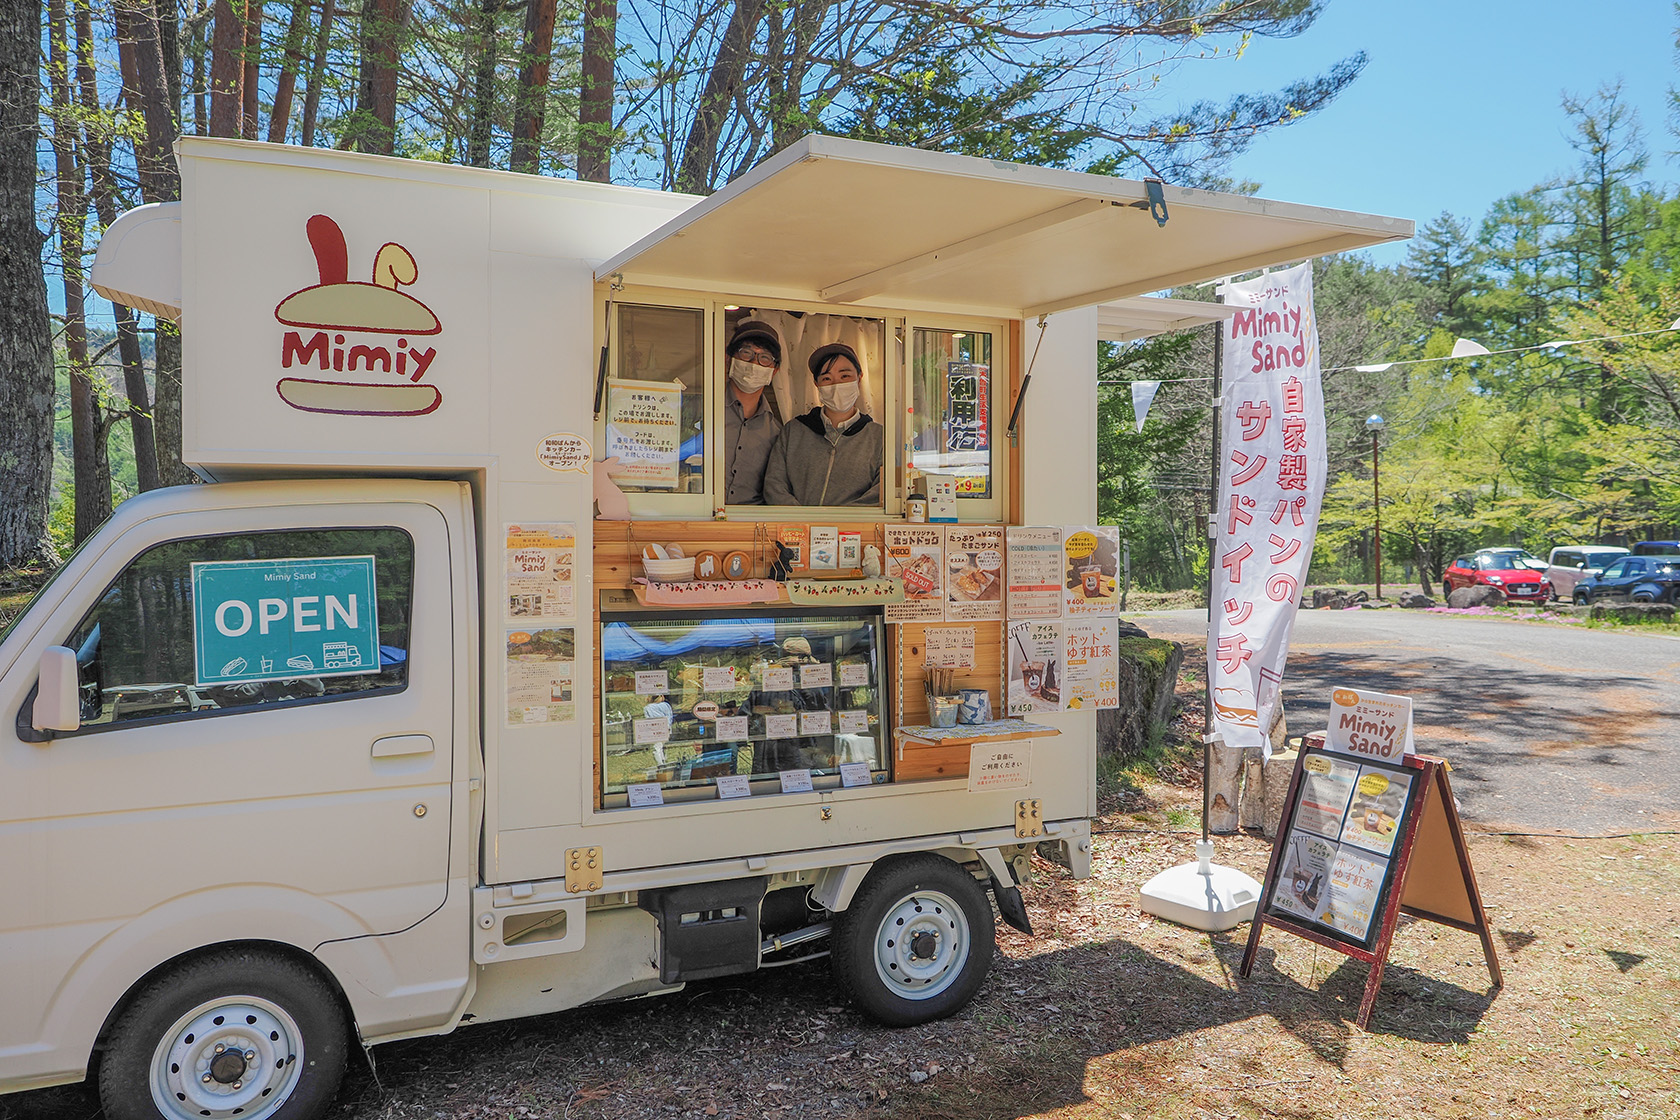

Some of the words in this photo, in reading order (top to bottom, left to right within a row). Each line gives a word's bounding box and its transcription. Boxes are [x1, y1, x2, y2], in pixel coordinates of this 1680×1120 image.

[1248, 286, 1289, 304] ミミーサンド
[1231, 301, 1302, 340] Mimiy
[282, 331, 437, 383] Mimiy
[1251, 330, 1306, 374] Sand
[631, 394, 657, 402] お客様へ
[634, 431, 656, 439] フードは、
[1265, 376, 1308, 604] 自家製パンの
[893, 536, 940, 546] ホットドッグ
[1216, 400, 1272, 675] サンドイッチ
[514, 554, 546, 565] Mimiy
[521, 562, 546, 573] Sand
[264, 573, 292, 583] Mimiy
[293, 572, 317, 580] Sand
[904, 571, 920, 583] SOLD
[918, 579, 930, 589] OUT
[214, 593, 359, 638] OPEN
[1067, 633, 1100, 646] ホット
[1066, 645, 1112, 660] ゆず紅茶
[1010, 703, 1033, 713] ¥450
[1093, 697, 1118, 707] ¥400
[1356, 705, 1395, 718] ミミーサンド
[1339, 713, 1397, 741] Mimiy
[1348, 733, 1394, 758] Sand
[991, 753, 1014, 761] ご自由に
[981, 761, 1023, 771] ご利用ください
[1307, 847, 1331, 858] カフェラテ
[1314, 842, 1328, 851] アイス
[1336, 857, 1366, 875] ホット
[1333, 868, 1375, 891] ゆず紅茶
[1276, 896, 1294, 908] ¥450
[1343, 922, 1366, 937] ¥400
